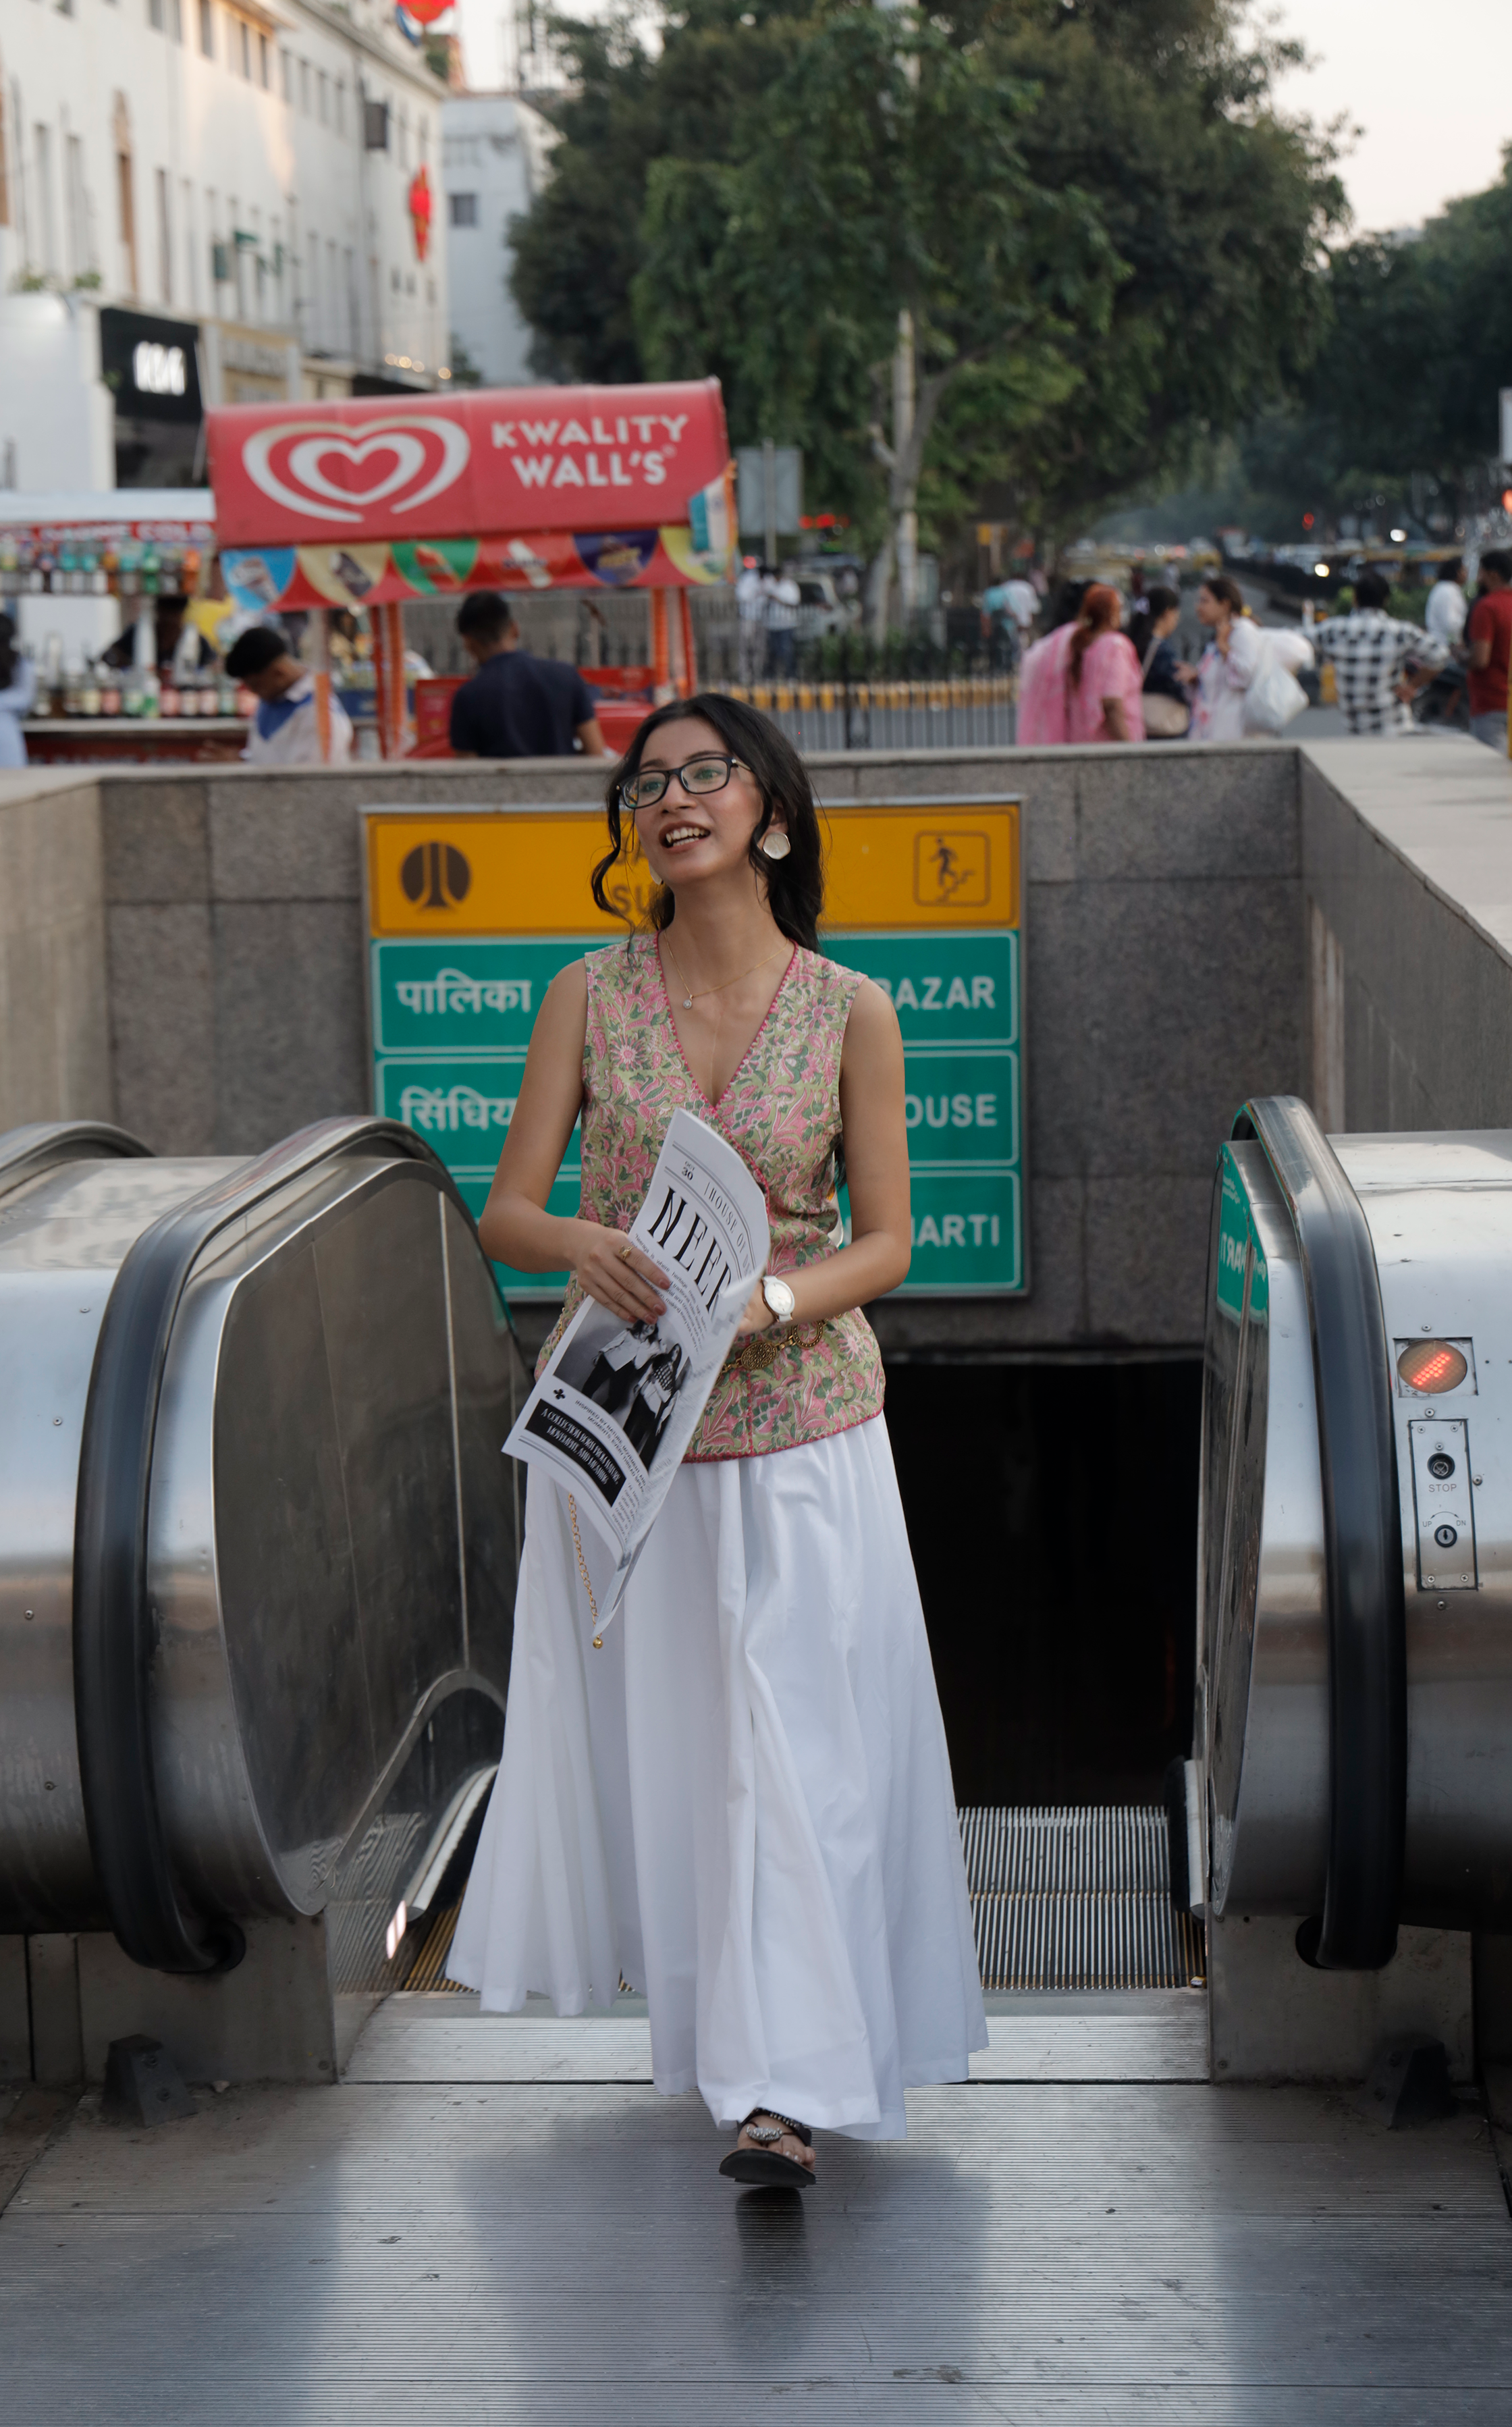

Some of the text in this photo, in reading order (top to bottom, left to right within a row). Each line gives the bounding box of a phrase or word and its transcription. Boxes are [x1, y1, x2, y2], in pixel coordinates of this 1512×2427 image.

[491, 412, 689, 449] KWALITY
[510, 450, 667, 489] WALL'S
[395, 967, 531, 1013] पालिका
[399, 1084, 518, 1131] सिंधिय
[905, 1094, 998, 1128] OUSE
[682, 1167, 693, 1180] 30
[684, 1161, 695, 1171] OCT
[709, 1188, 738, 1234] HOUSE
[910, 1214, 1000, 1248] ARTI
[655, 1258, 670, 1272] where
[671, 1271, 688, 1289] heritage
[665, 1297, 682, 1313] making
[673, 1295, 683, 1304] and
[541, 1408, 549, 1417] A
[574, 1399, 600, 1420] INSPIRED
[599, 1417, 608, 1426] BY
[576, 1446, 591, 1463] AND
[1428, 1484, 1457, 1493] STOP
